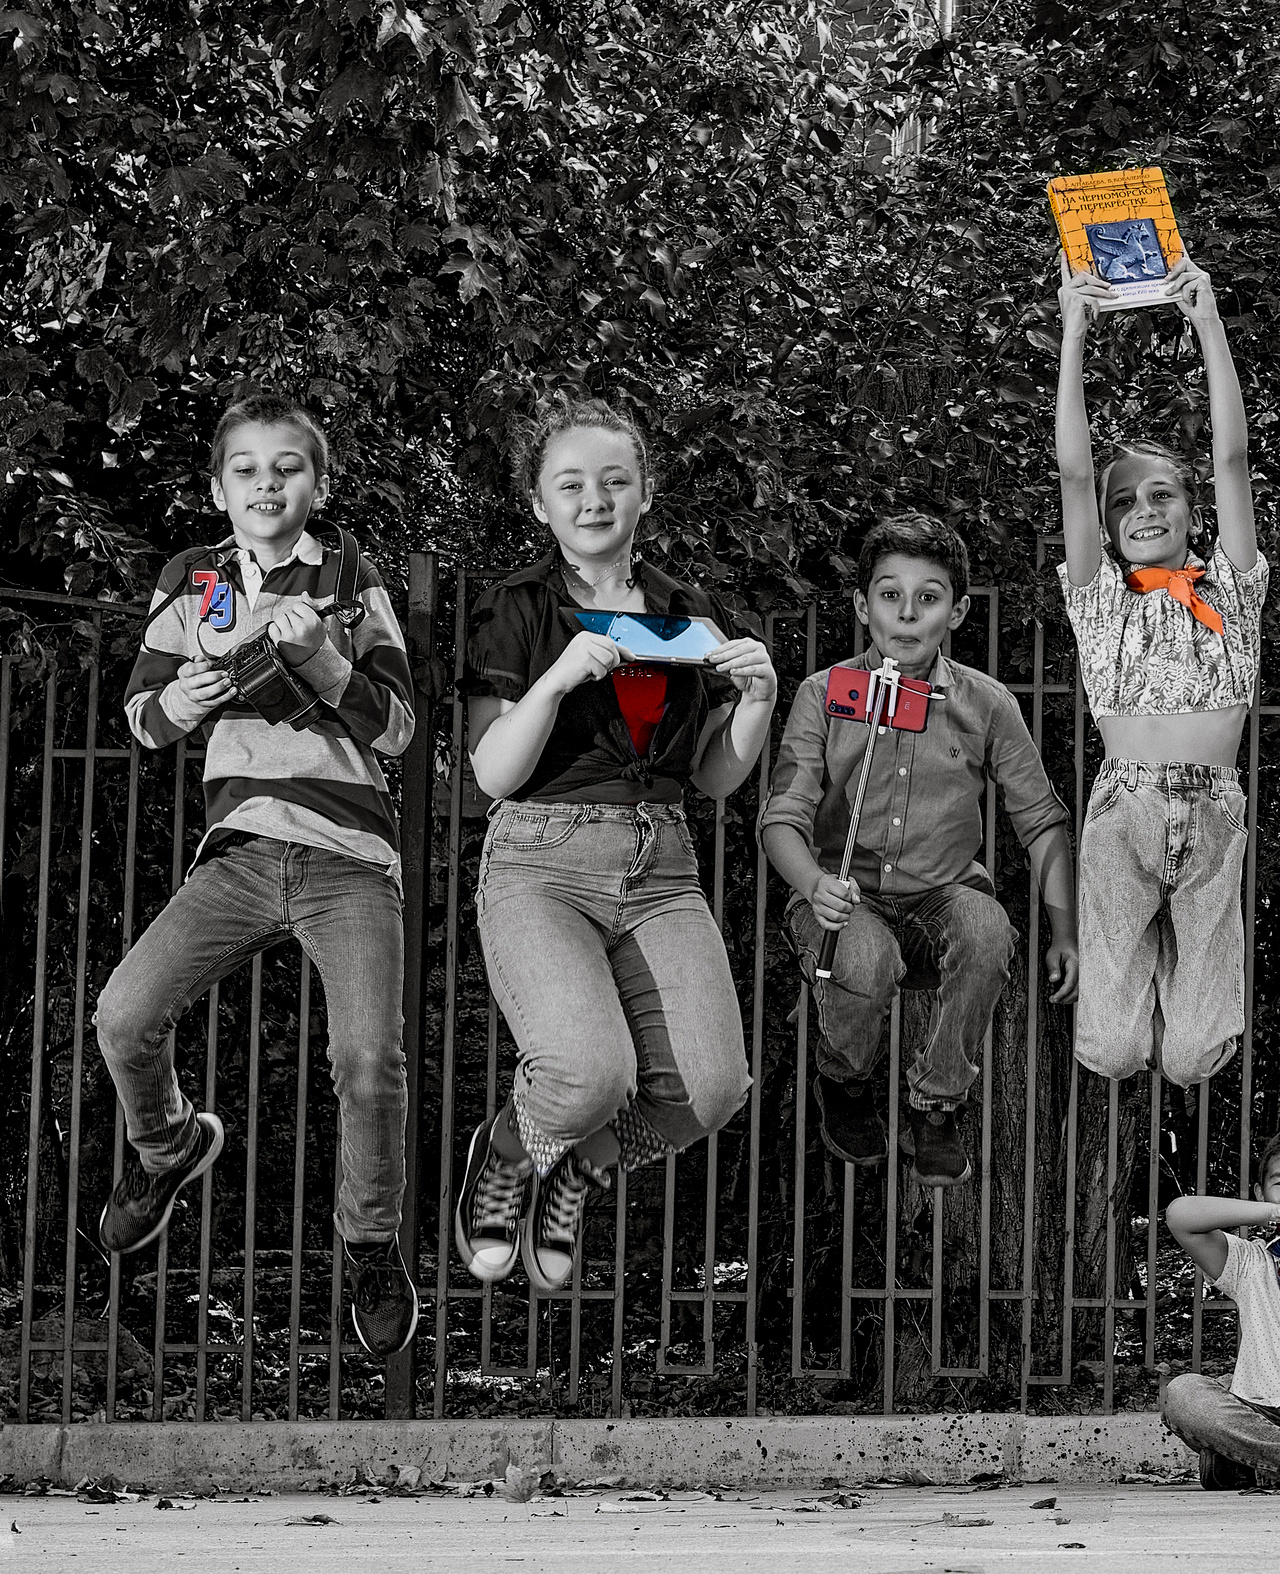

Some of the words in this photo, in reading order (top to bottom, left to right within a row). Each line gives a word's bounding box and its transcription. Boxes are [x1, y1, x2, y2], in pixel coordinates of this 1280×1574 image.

[1062, 196, 1076, 204] НА
[1078, 187, 1160, 202] ЧЕРНОМОРСКОМ
[192, 570, 234, 630] 79
